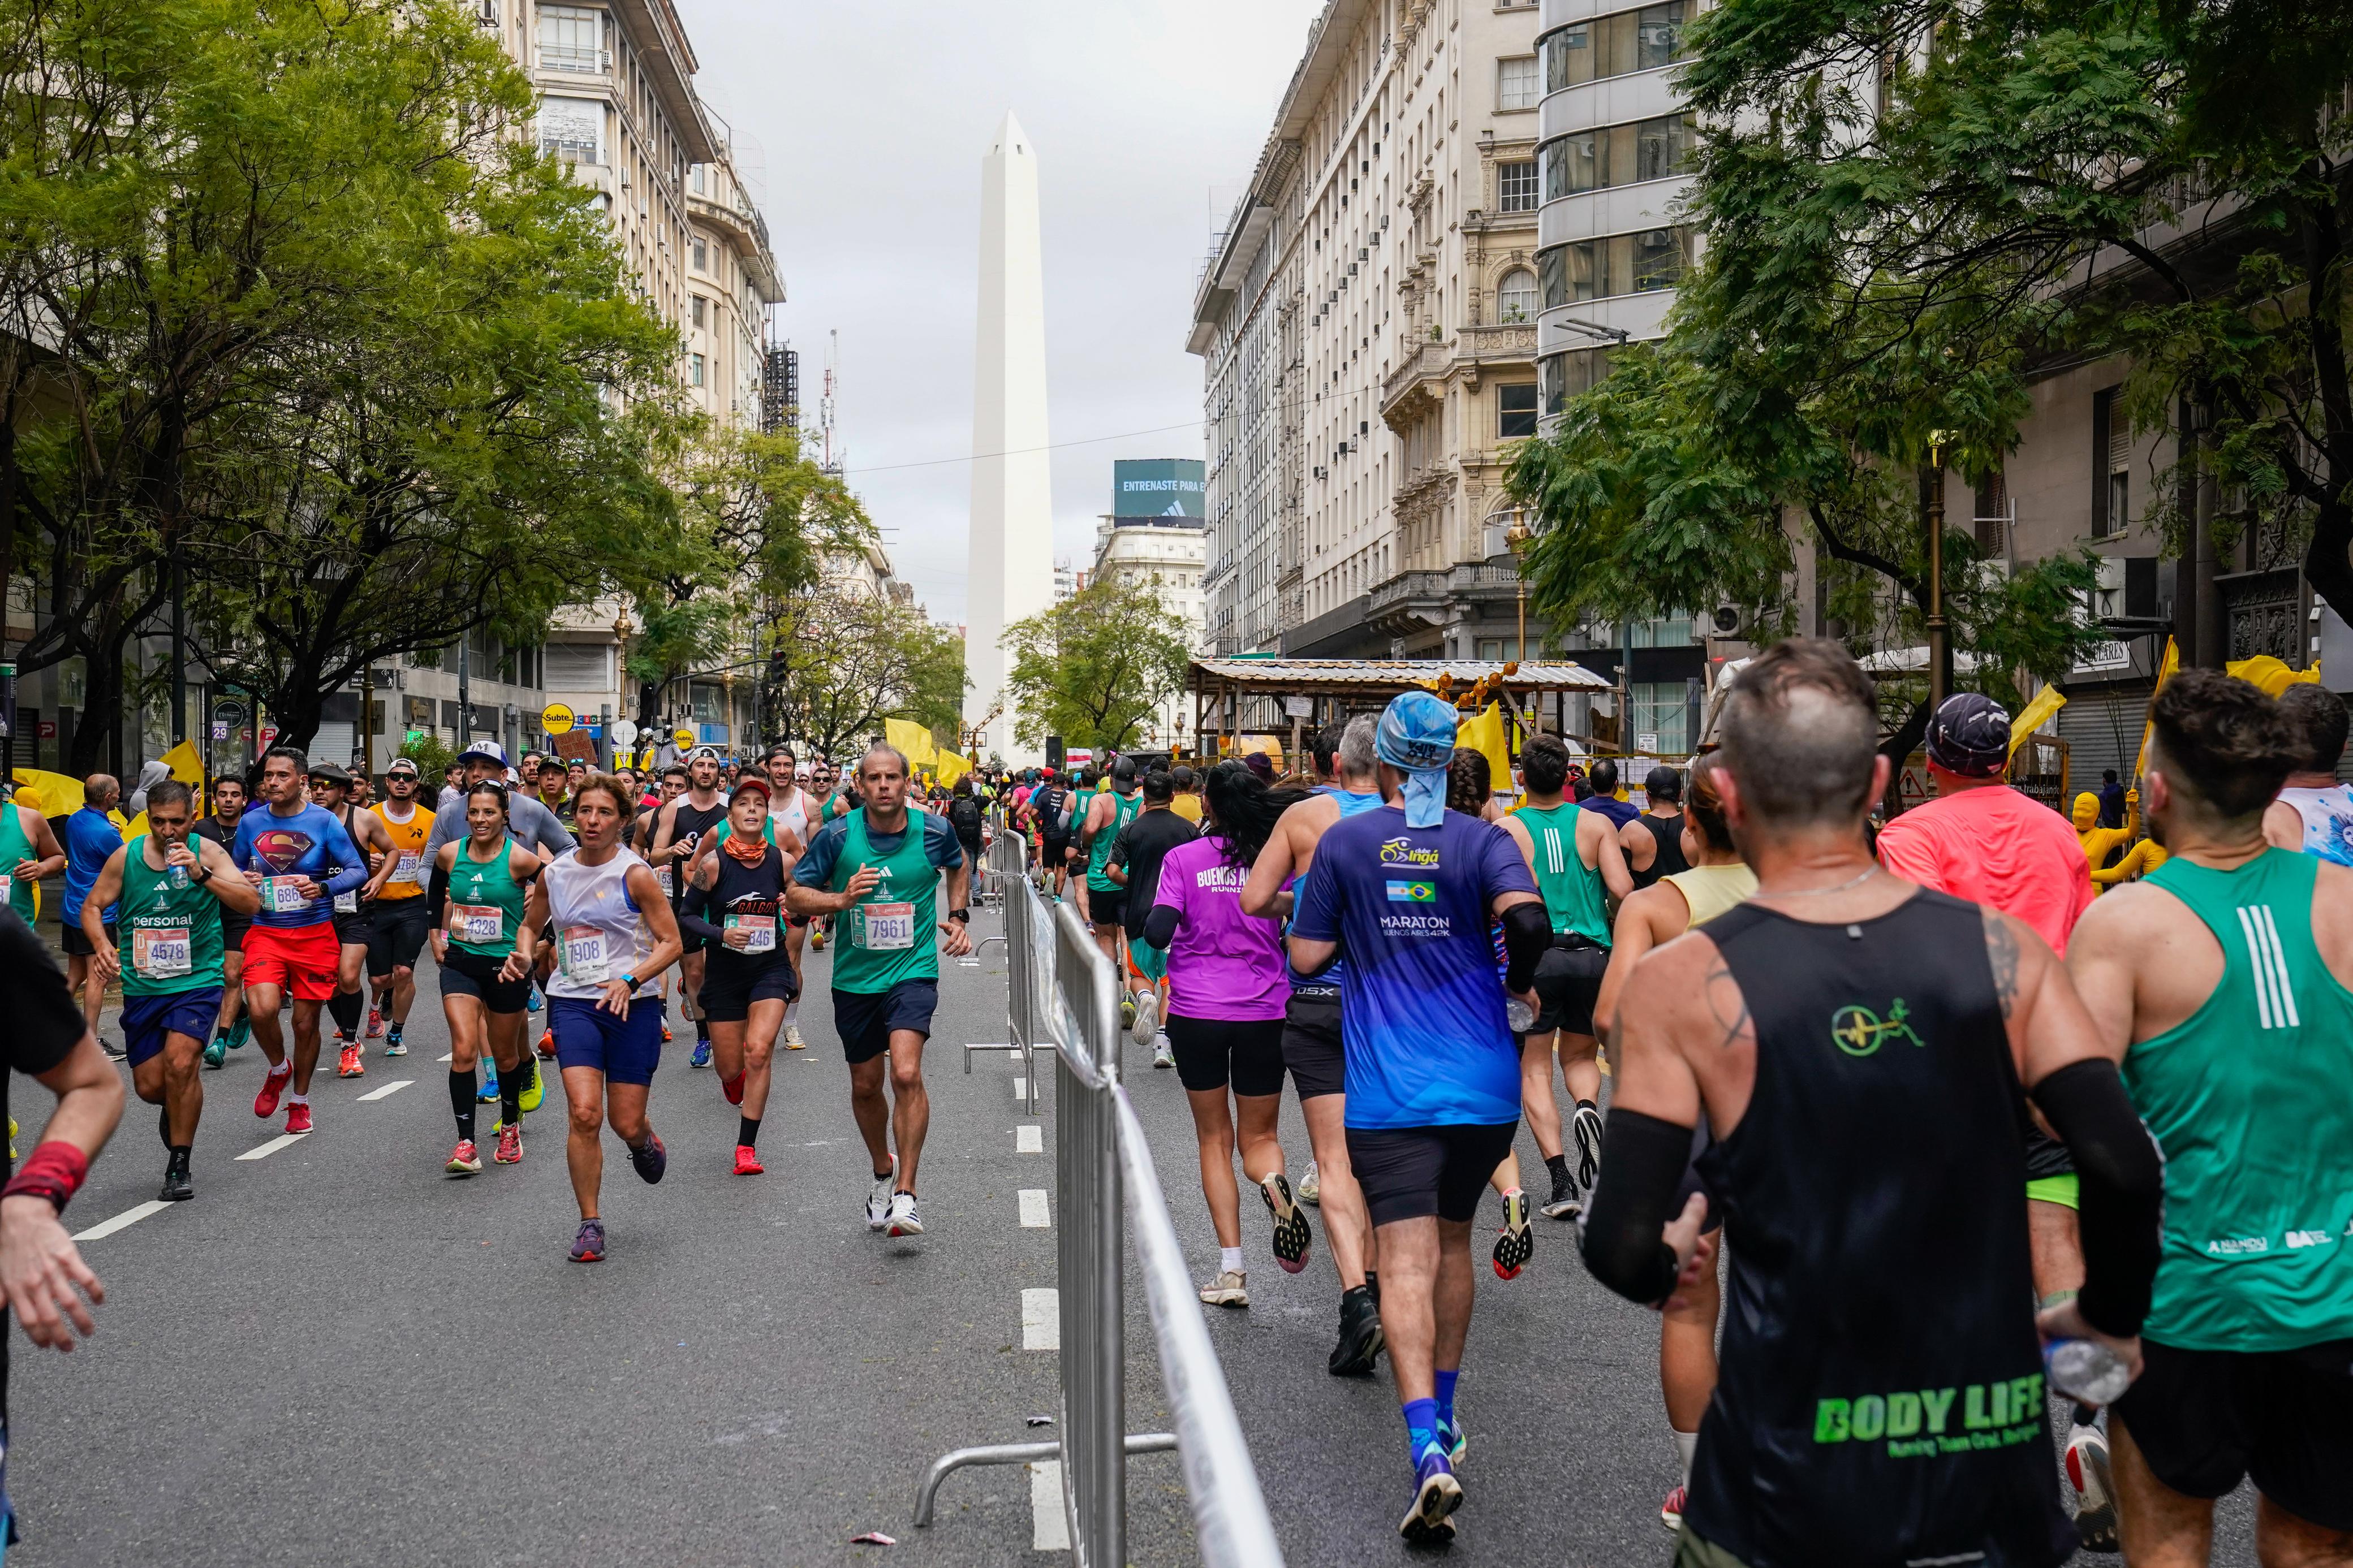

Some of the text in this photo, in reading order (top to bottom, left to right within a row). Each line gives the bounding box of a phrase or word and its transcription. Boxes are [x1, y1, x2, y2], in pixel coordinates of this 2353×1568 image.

[1123, 480, 1178, 491] ENTRENASTE
[1180, 481, 1198, 492] PARA
[213, 727, 227, 739] 29
[2024, 784, 2059, 796] trabajando
[1408, 850, 1439, 865] Ingá
[1196, 866, 1236, 888] BUENOS
[277, 887, 302, 903] 686
[455, 908, 463, 922] D
[738, 902, 777, 913] GALGOS
[133, 913, 193, 927] personal
[855, 909, 863, 926] E
[1380, 915, 1450, 928] MARATON
[468, 918, 496, 935] 4328
[871, 919, 906, 938] 7961
[137, 934, 145, 949] D
[748, 930, 769, 946] 846
[151, 943, 184, 960] 4578
[568, 940, 600, 964] 7908
[1813, 1372, 2046, 1444] BODY LIFE
[1936, 1435, 1972, 1453] Team
